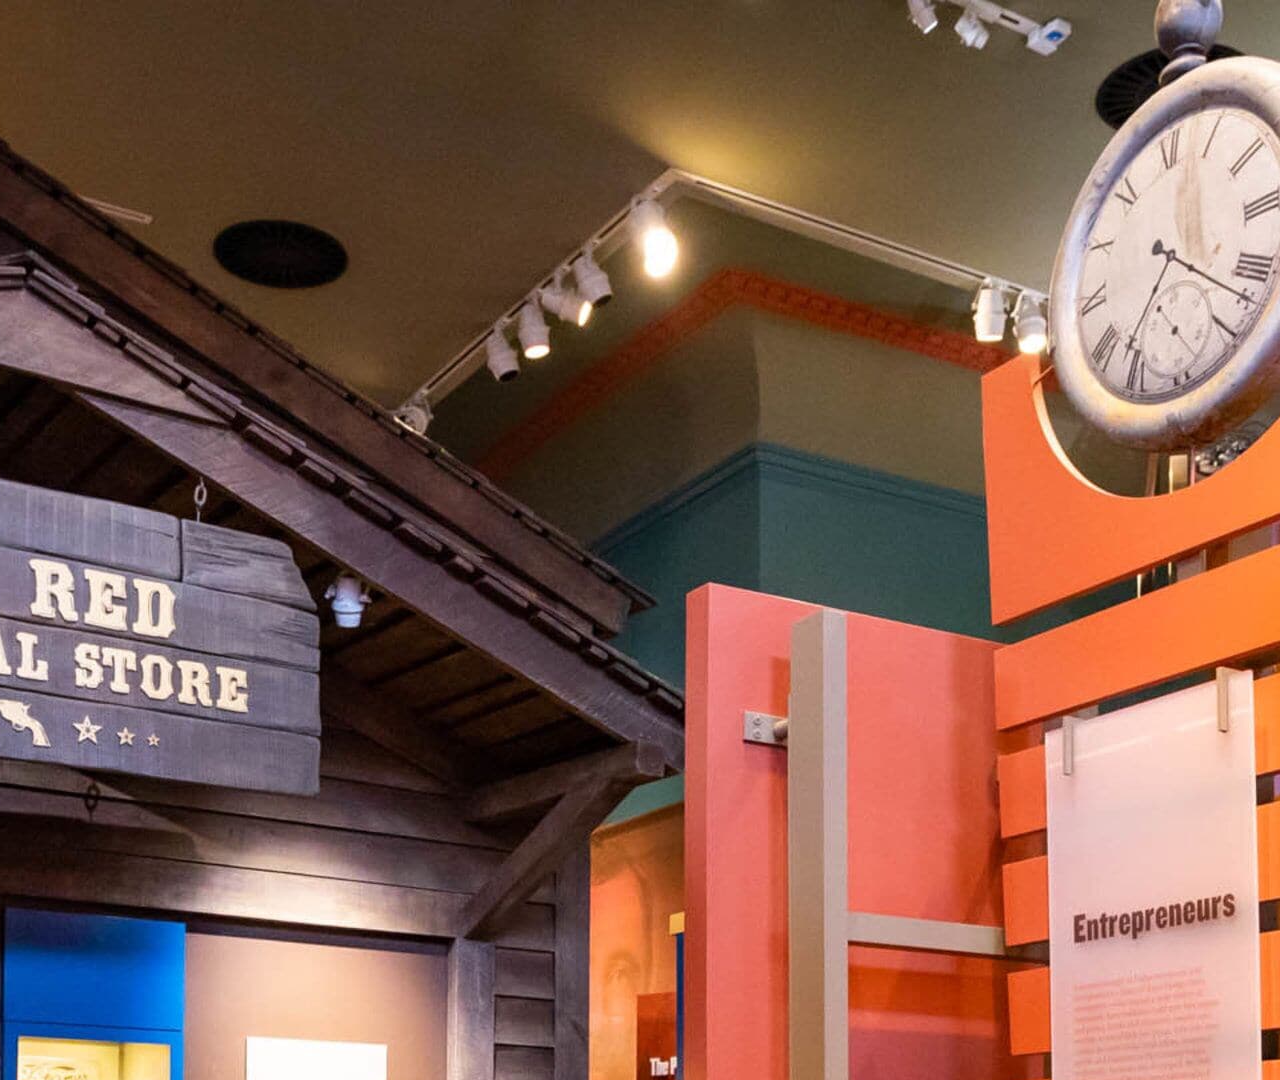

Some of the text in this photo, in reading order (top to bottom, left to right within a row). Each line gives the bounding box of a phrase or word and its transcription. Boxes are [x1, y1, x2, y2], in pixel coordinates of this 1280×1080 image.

[1228, 136, 1265, 177] II
[1244, 186, 1280, 227] III
[1233, 251, 1274, 283] IIII
[28, 557, 177, 639] RED
[73, 642, 248, 714] STORE
[1073, 893, 1236, 943] Entrepreneurs
